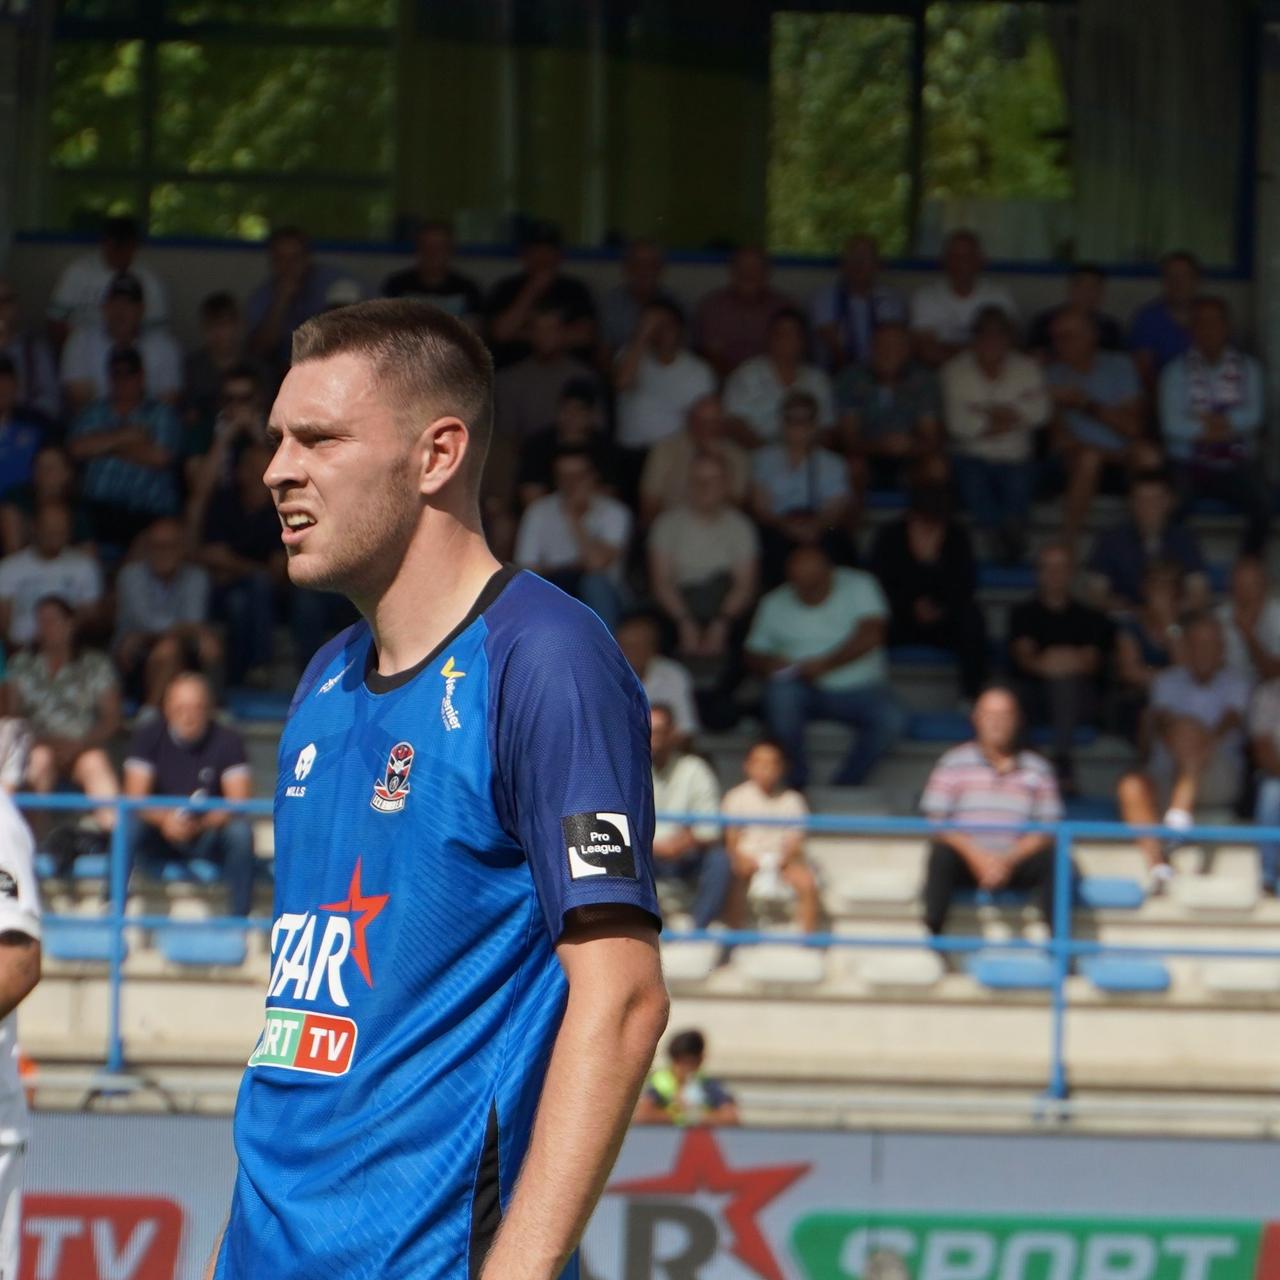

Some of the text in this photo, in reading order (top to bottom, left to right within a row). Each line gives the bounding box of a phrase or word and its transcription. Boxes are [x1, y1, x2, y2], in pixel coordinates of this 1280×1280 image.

[285, 786, 307, 797] MILLS
[590, 831, 610, 842] Pro
[580, 844, 622, 855] League
[308, 1026, 349, 1062] TV
